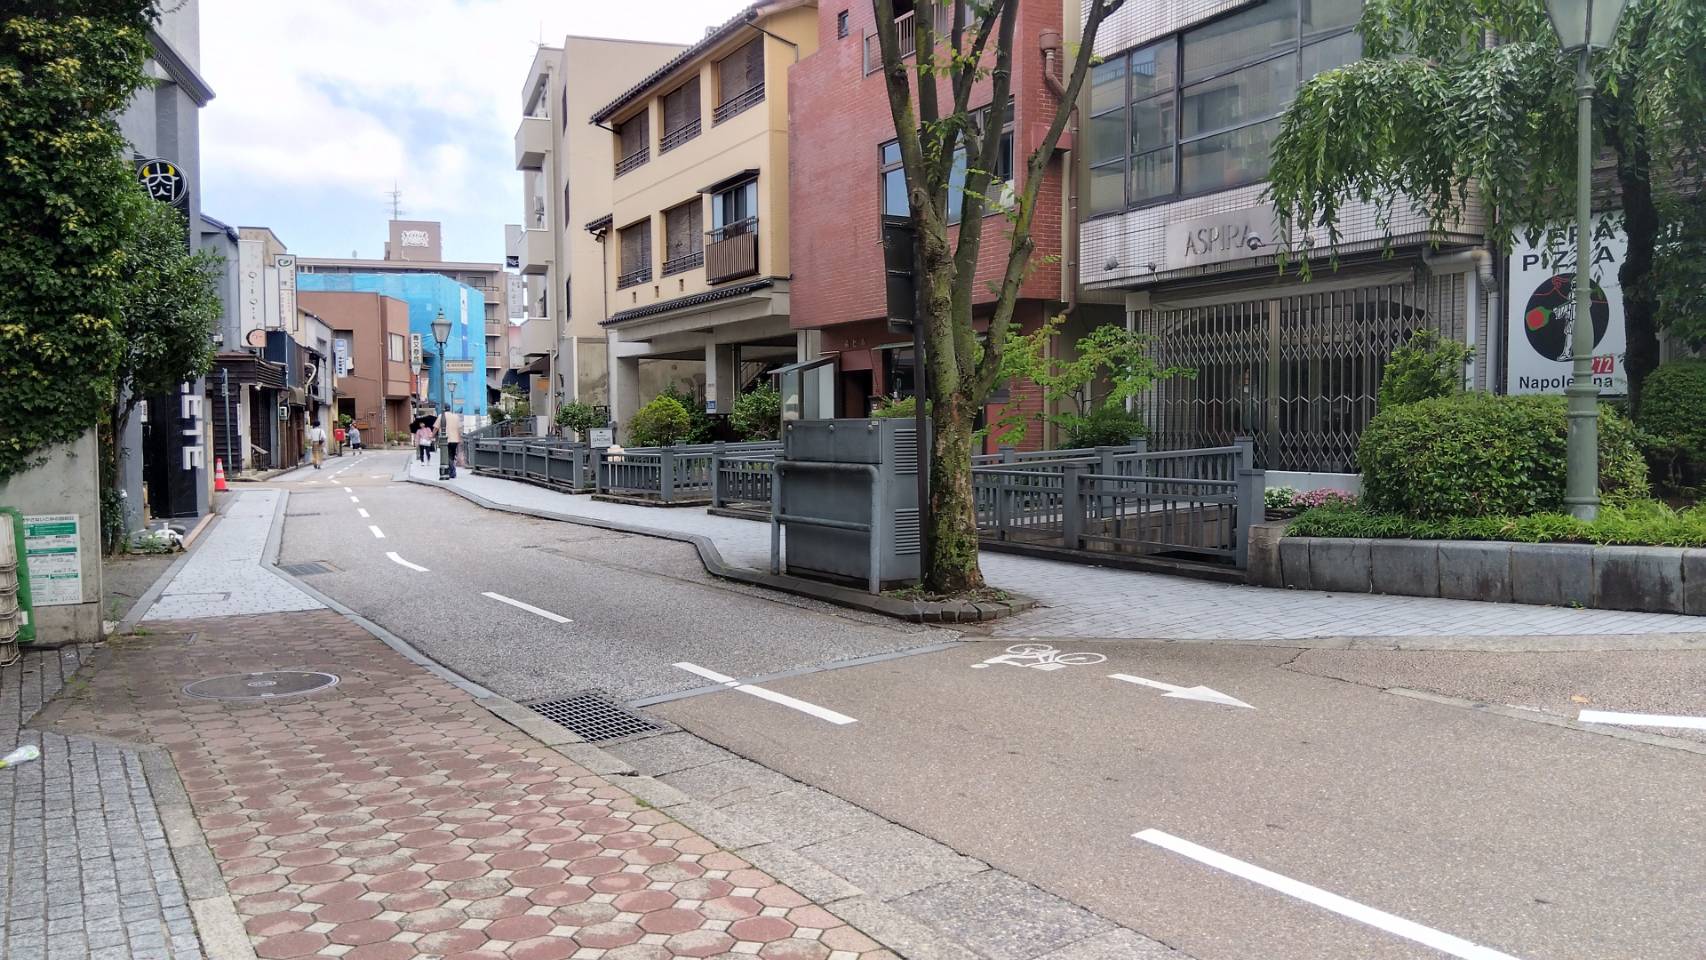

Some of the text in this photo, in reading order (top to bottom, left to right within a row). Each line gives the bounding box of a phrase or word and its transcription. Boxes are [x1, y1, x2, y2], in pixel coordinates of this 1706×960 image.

[1522, 245, 1615, 272] PZA
[1519, 375, 1613, 391] Napolena
[181, 381, 204, 471] ETE
